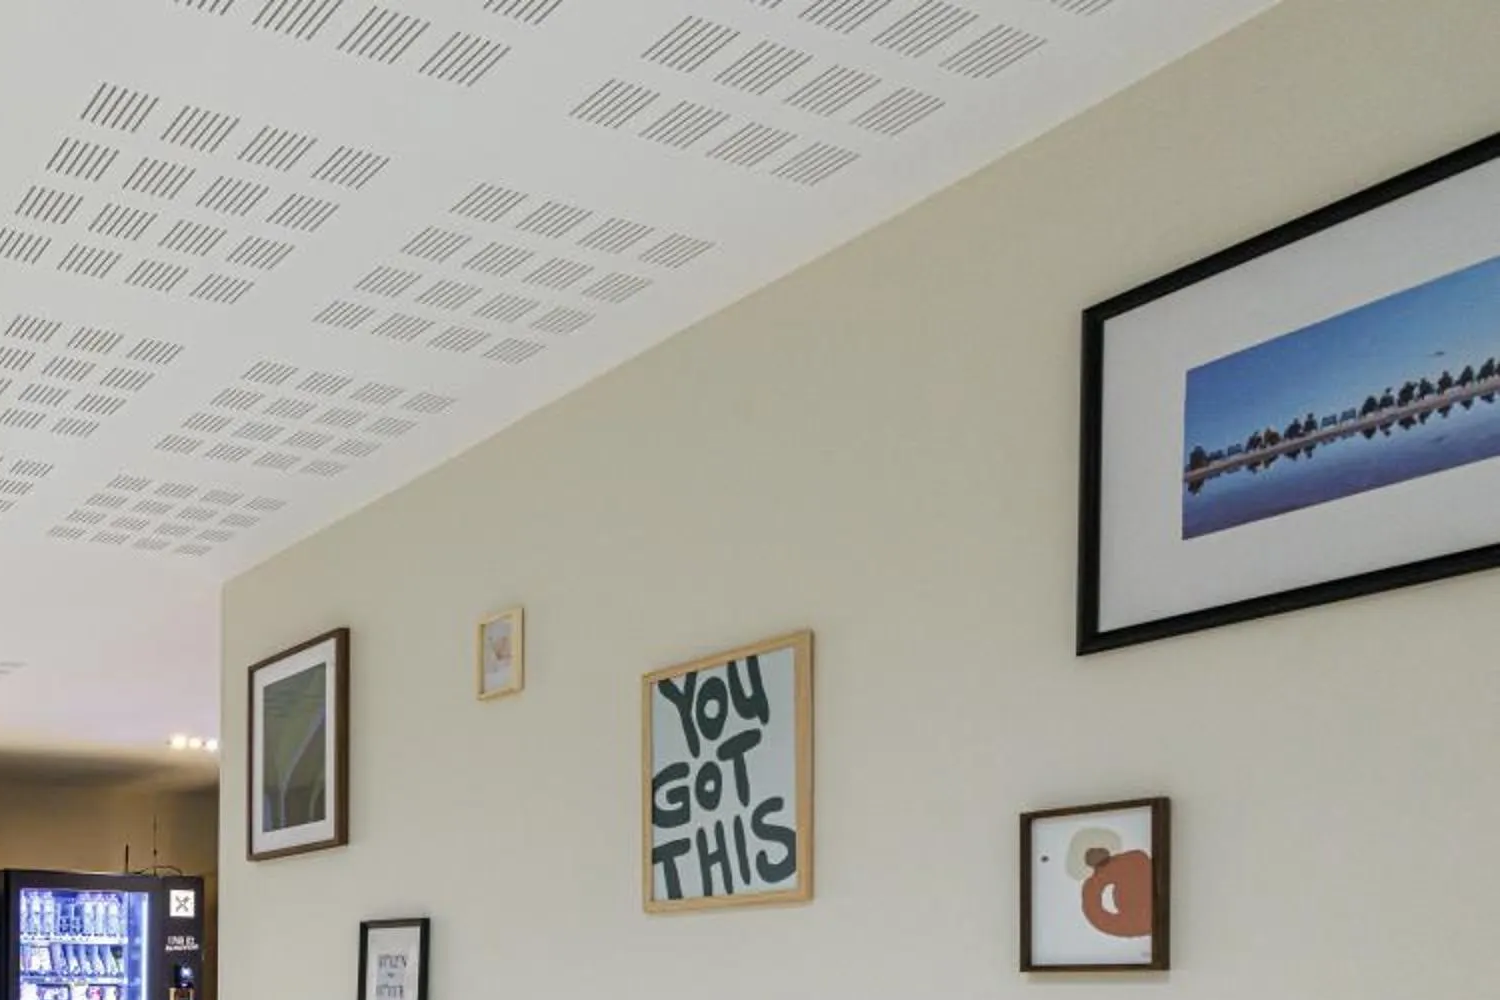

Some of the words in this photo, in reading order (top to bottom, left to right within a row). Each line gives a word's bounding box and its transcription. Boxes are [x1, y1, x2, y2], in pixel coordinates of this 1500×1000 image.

[657, 654, 770, 759] YOU
[651, 728, 762, 829] GOT
[651, 796, 796, 900] THIS
